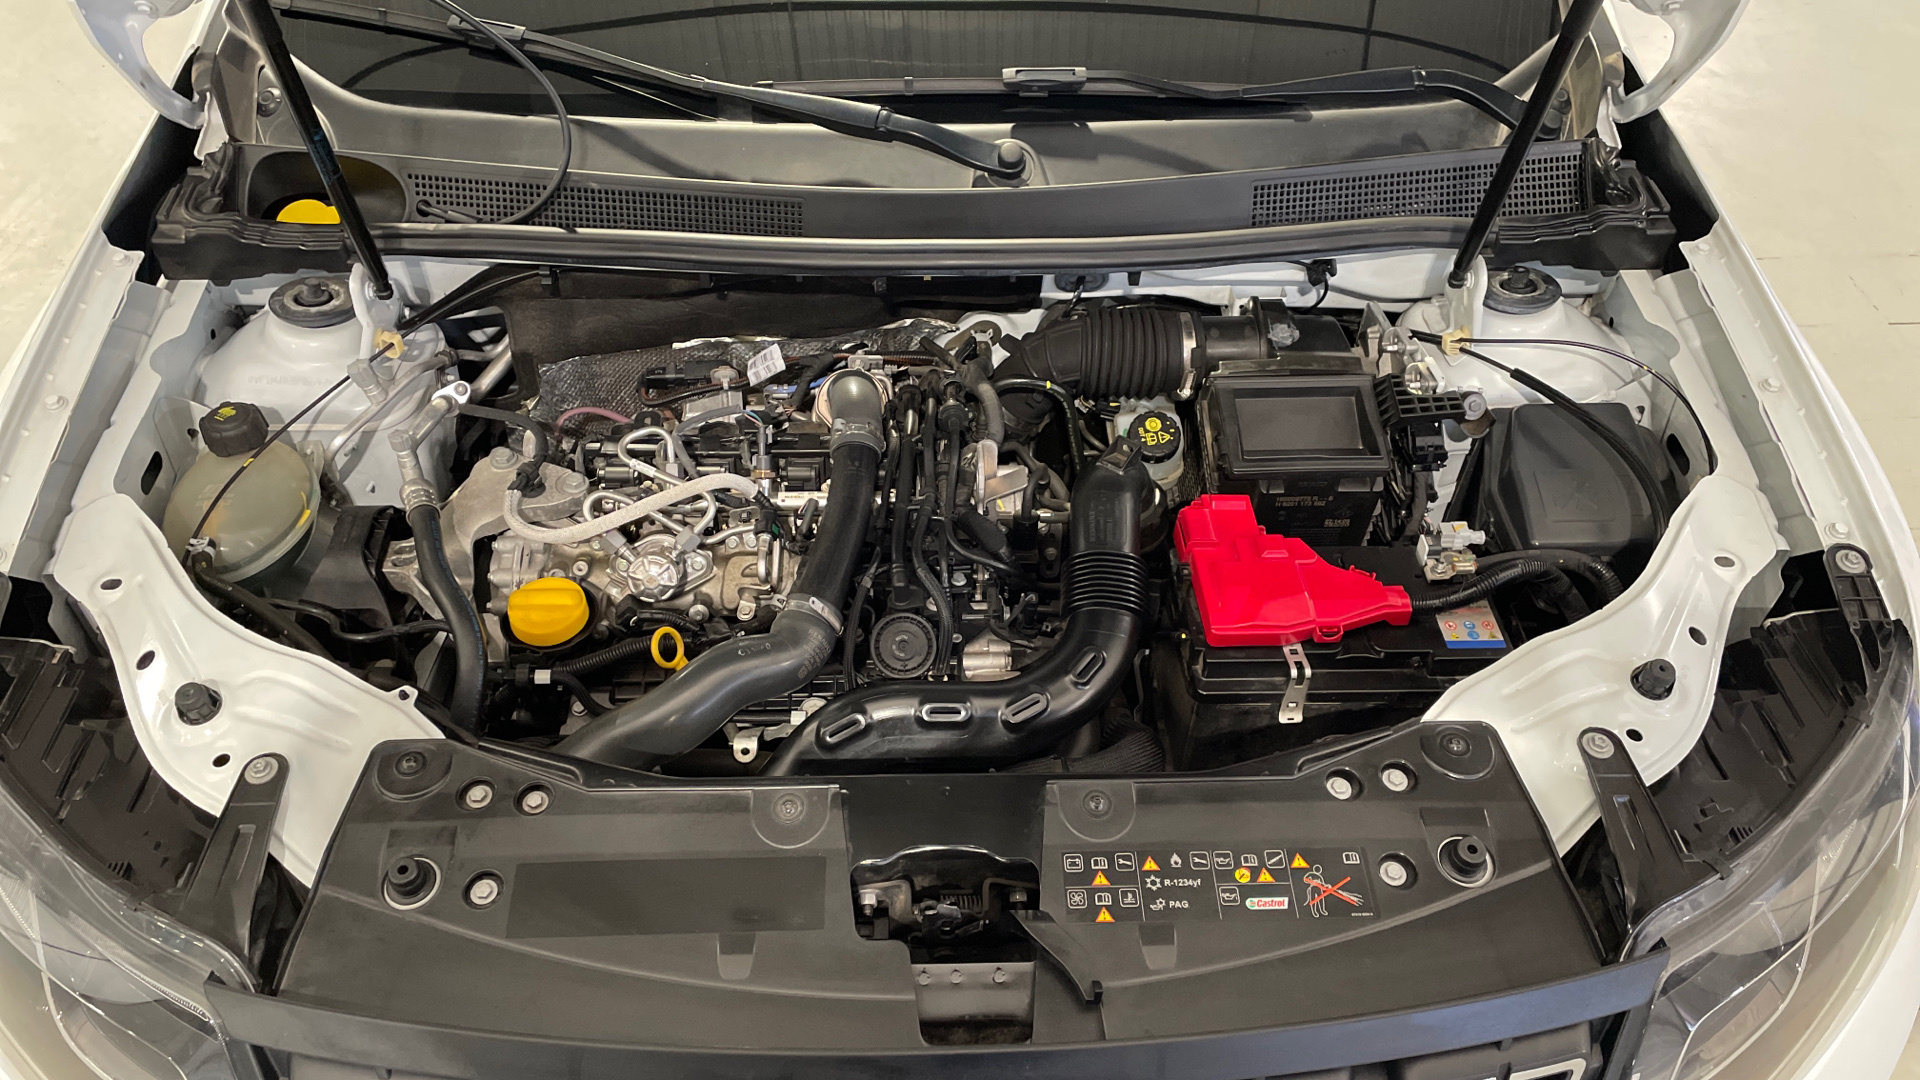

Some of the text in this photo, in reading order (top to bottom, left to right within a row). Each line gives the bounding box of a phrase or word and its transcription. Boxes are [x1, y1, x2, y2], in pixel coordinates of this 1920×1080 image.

[1164, 879, 1201, 888] R-1234yf
[1169, 900, 1189, 909] PAG
[1256, 899, 1286, 908] Castrol
